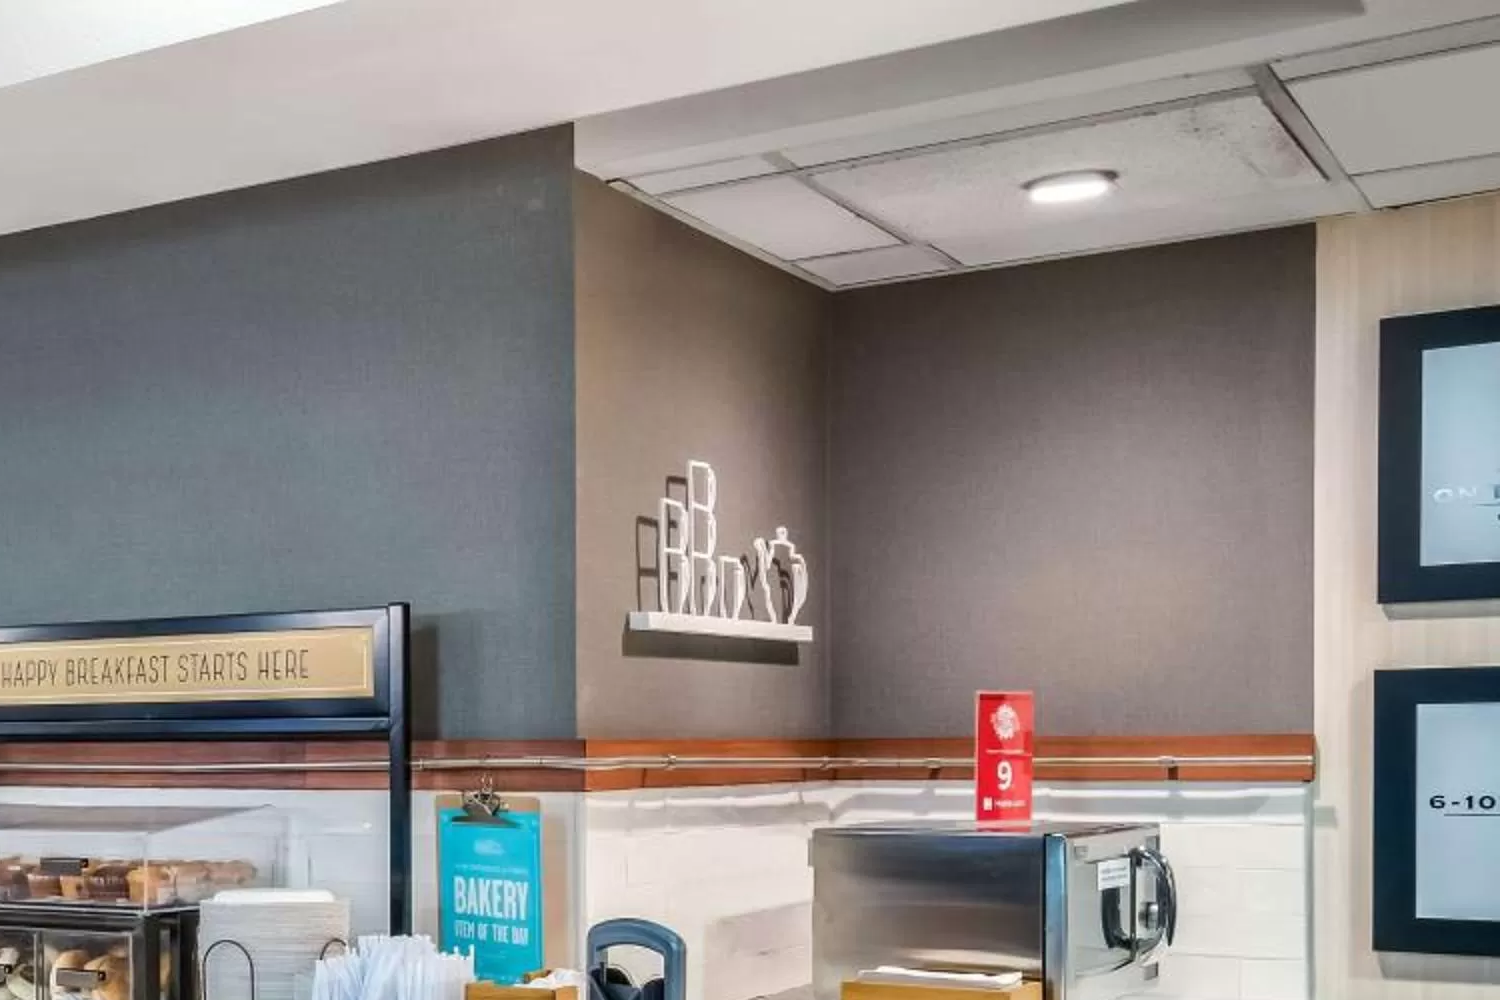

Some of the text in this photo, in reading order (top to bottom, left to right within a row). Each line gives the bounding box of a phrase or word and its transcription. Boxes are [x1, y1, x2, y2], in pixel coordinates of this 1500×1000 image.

[1, 649, 309, 689] HAPPY BREAKFAST STARTS HERE
[997, 760, 1013, 791] 9
[453, 875, 529, 921] BAKERY
[454, 919, 475, 940] ITEM
[477, 923, 488, 942] OF
[492, 923, 509, 944] THE
